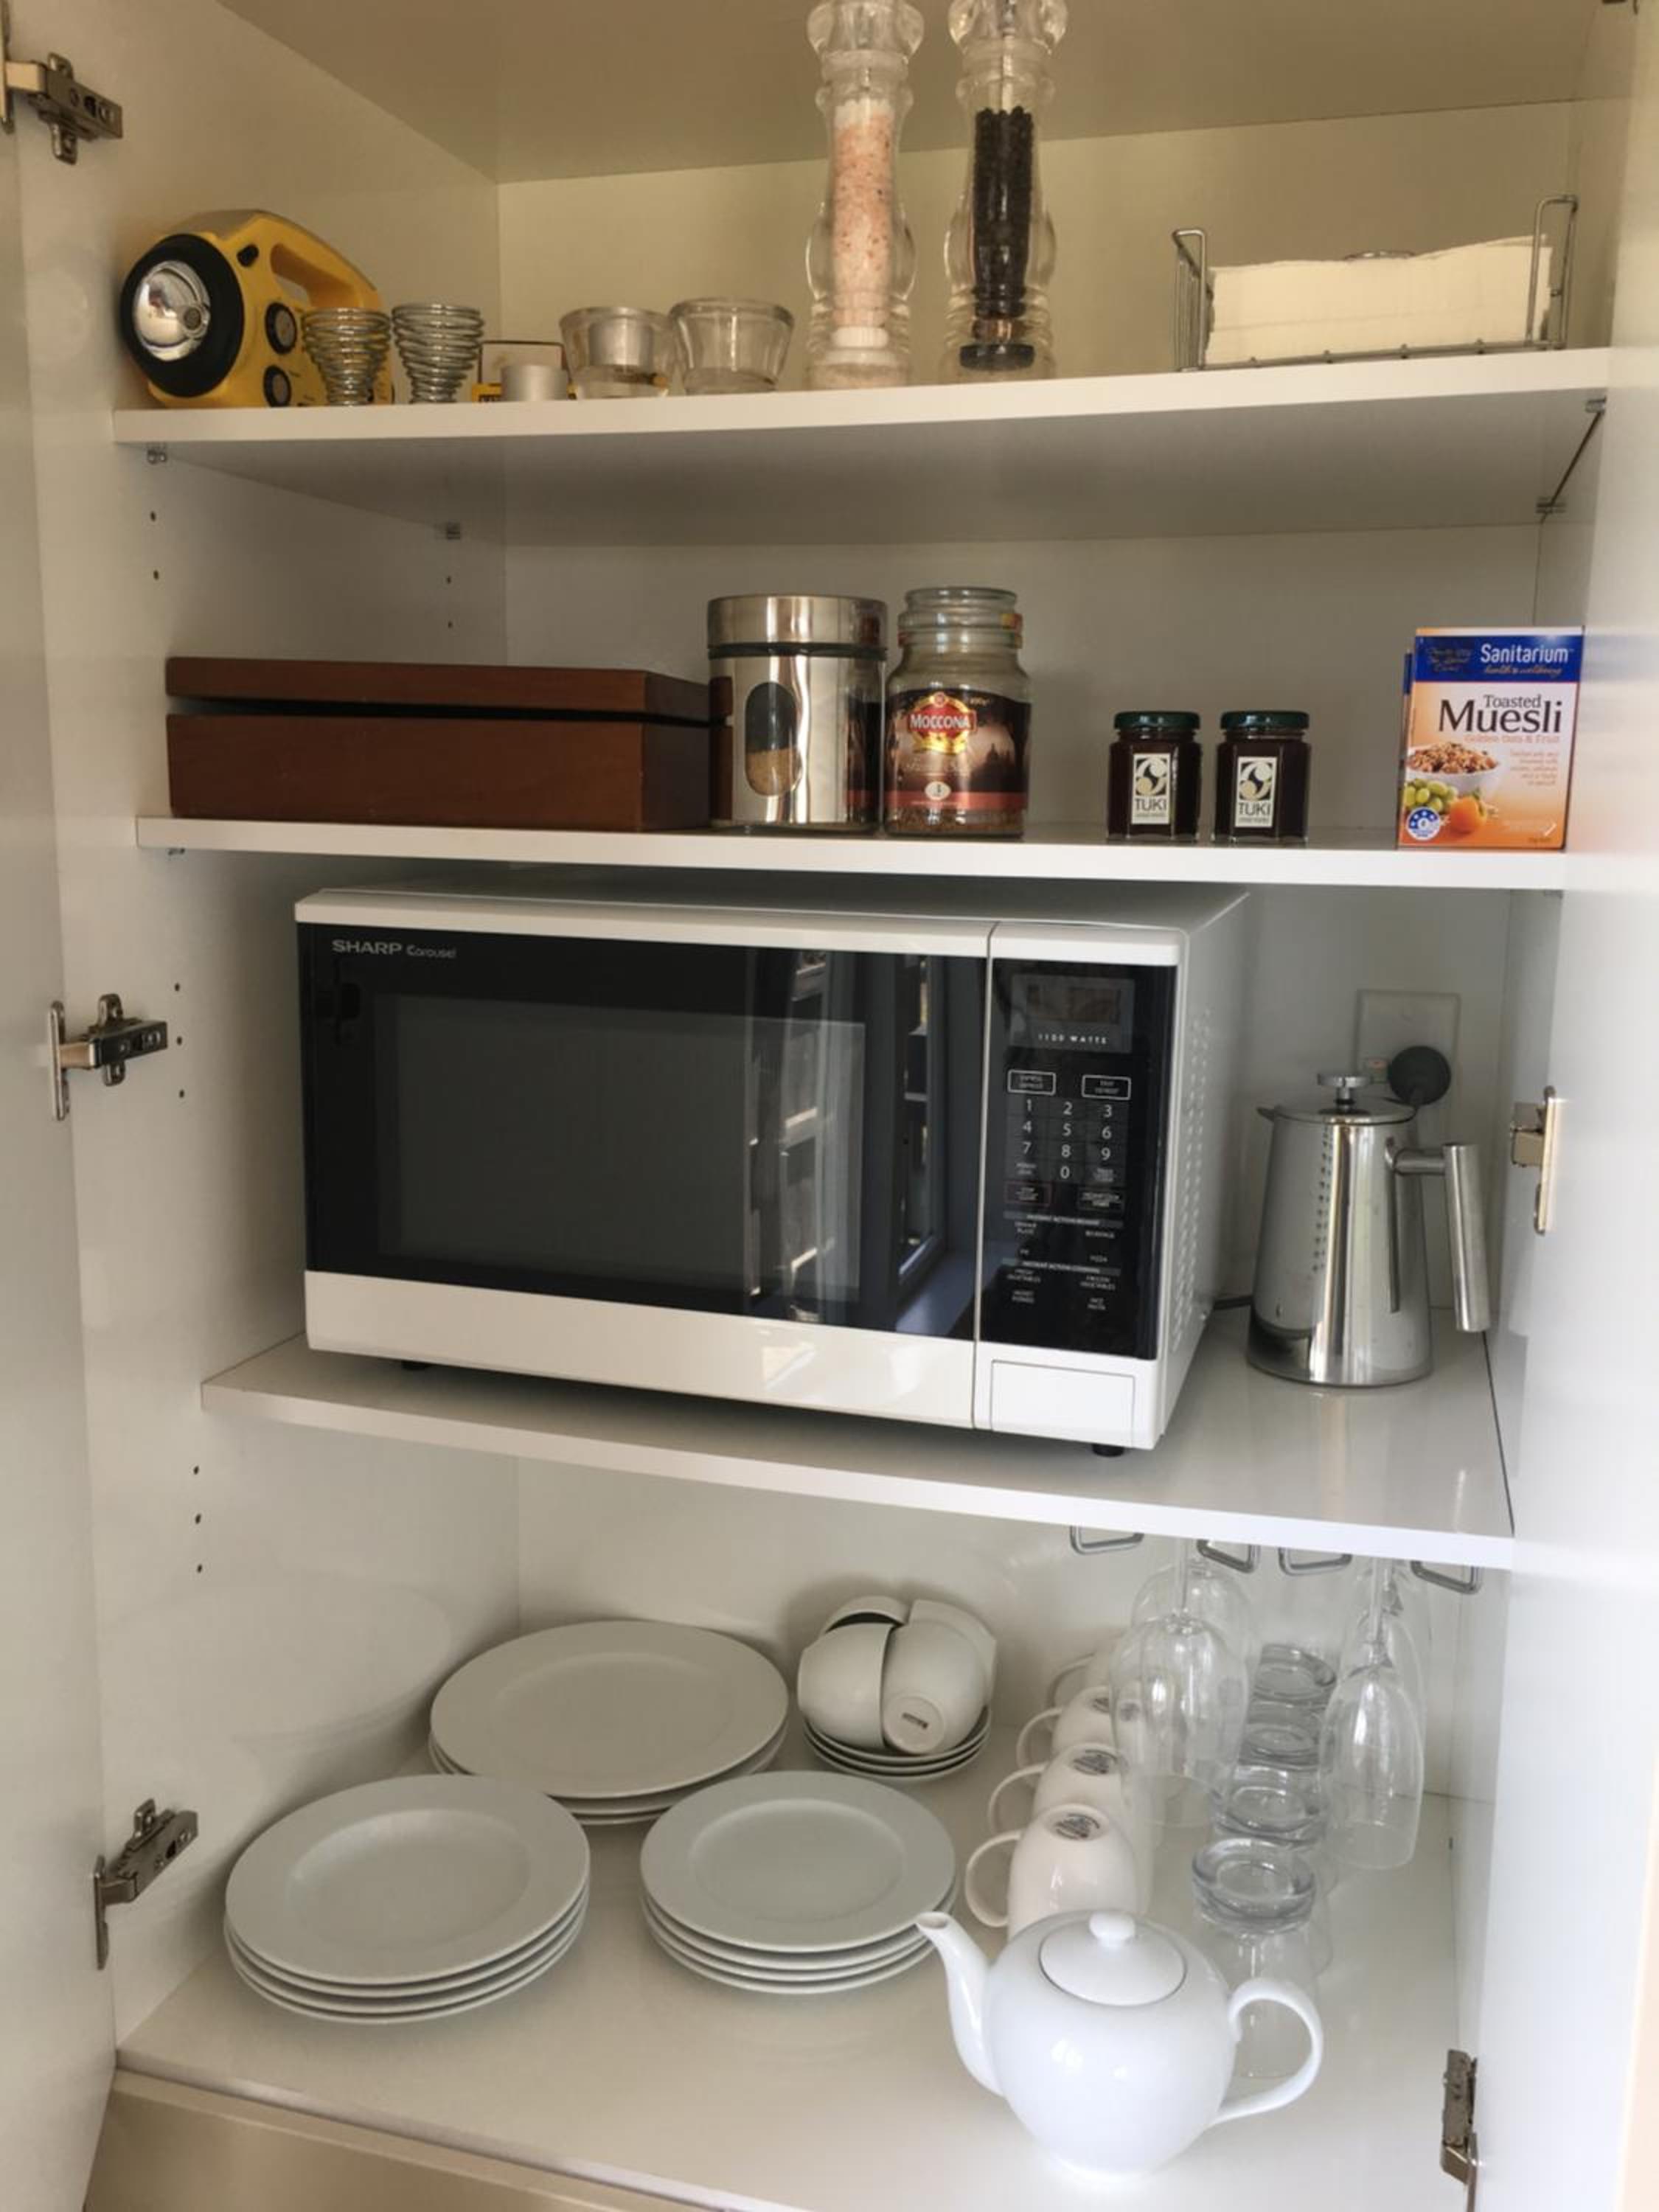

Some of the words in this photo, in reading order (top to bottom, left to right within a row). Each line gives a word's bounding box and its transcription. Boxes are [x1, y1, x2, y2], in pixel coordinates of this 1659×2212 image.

[1480, 643, 1568, 664] Sanitarium
[1484, 694, 1542, 708] Toasted
[910, 714, 970, 728] MOCCONA
[1439, 699, 1563, 733] Muesli
[1135, 799, 1167, 812] TUKI
[1238, 802, 1271, 815] TUKI
[332, 939, 402, 955] SHARP
[406, 945, 457, 959] Carousel
[1026, 1099, 1032, 1111] 1
[1063, 1102, 1073, 1115] 2
[1104, 1105, 1112, 1118] 3
[1023, 1121, 1032, 1133] 4
[1062, 1123, 1071, 1136] 5
[1102, 1126, 1112, 1139] 6
[1023, 1141, 1032, 1154] 7
[1062, 1144, 1071, 1158] 8
[1101, 1147, 1111, 1161] 9
[1060, 1166, 1070, 1179] 0
